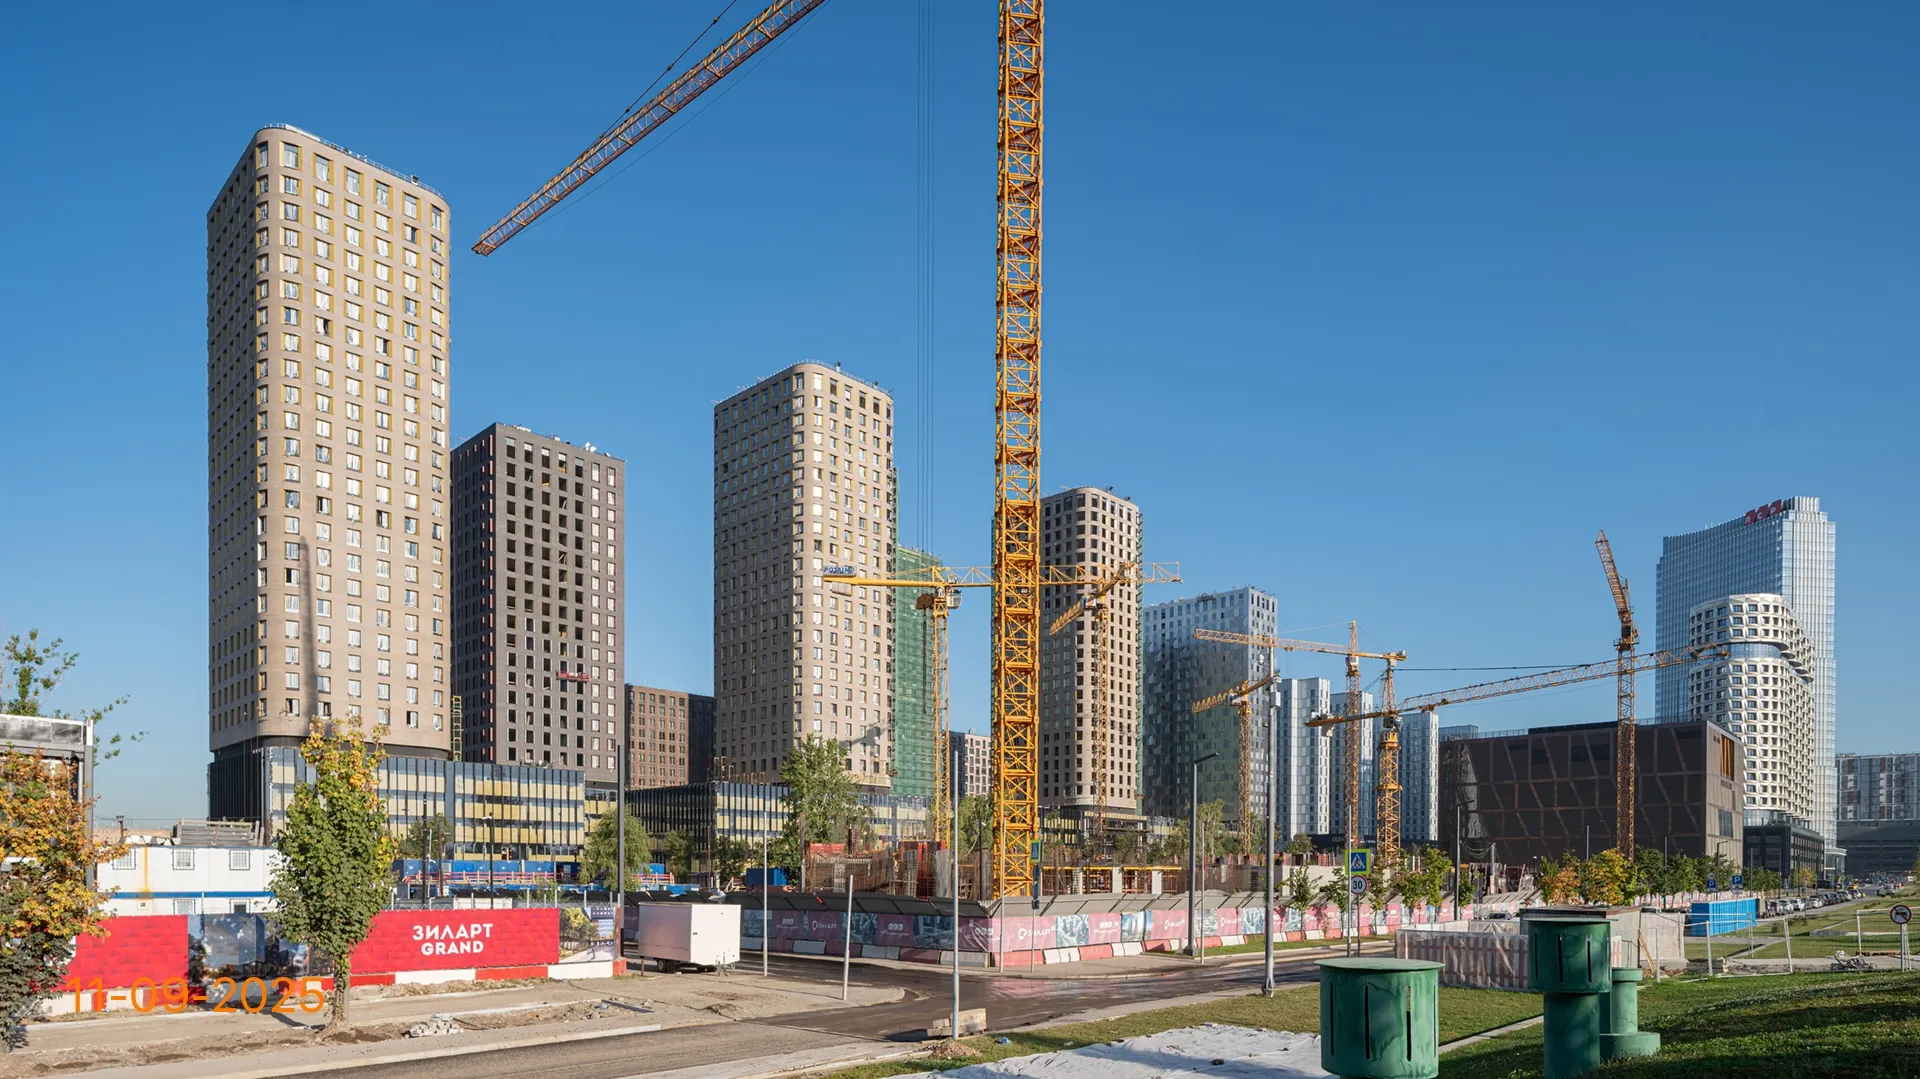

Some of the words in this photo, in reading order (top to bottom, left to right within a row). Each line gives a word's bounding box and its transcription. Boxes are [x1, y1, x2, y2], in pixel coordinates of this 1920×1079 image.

[1352, 880, 1363, 890] 30
[412, 923, 494, 941] ЗИЛАРТ
[421, 940, 484, 956] GRAND
